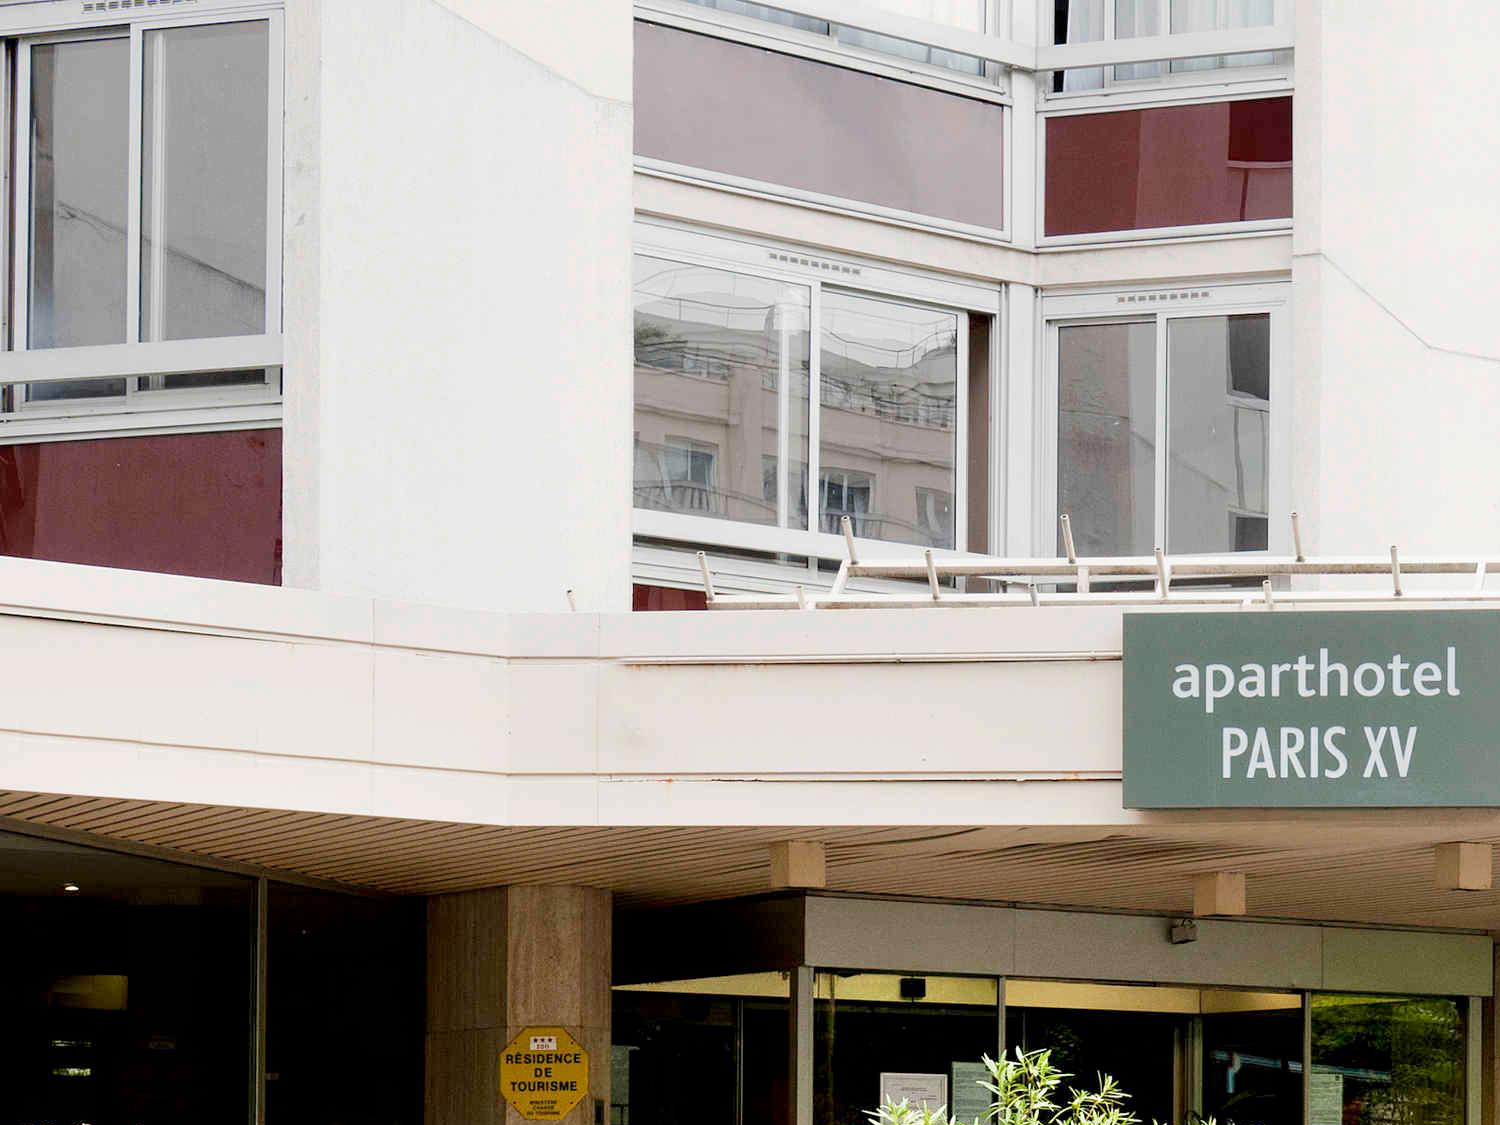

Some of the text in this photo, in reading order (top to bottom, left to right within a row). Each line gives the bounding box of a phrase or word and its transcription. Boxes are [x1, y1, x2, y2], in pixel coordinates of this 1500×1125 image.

[1171, 646, 1461, 713] aparthotel
[1222, 726, 1418, 779] PARIS XV
[510, 1081, 577, 1092] TOURISME
[534, 1067, 553, 1078] DE
